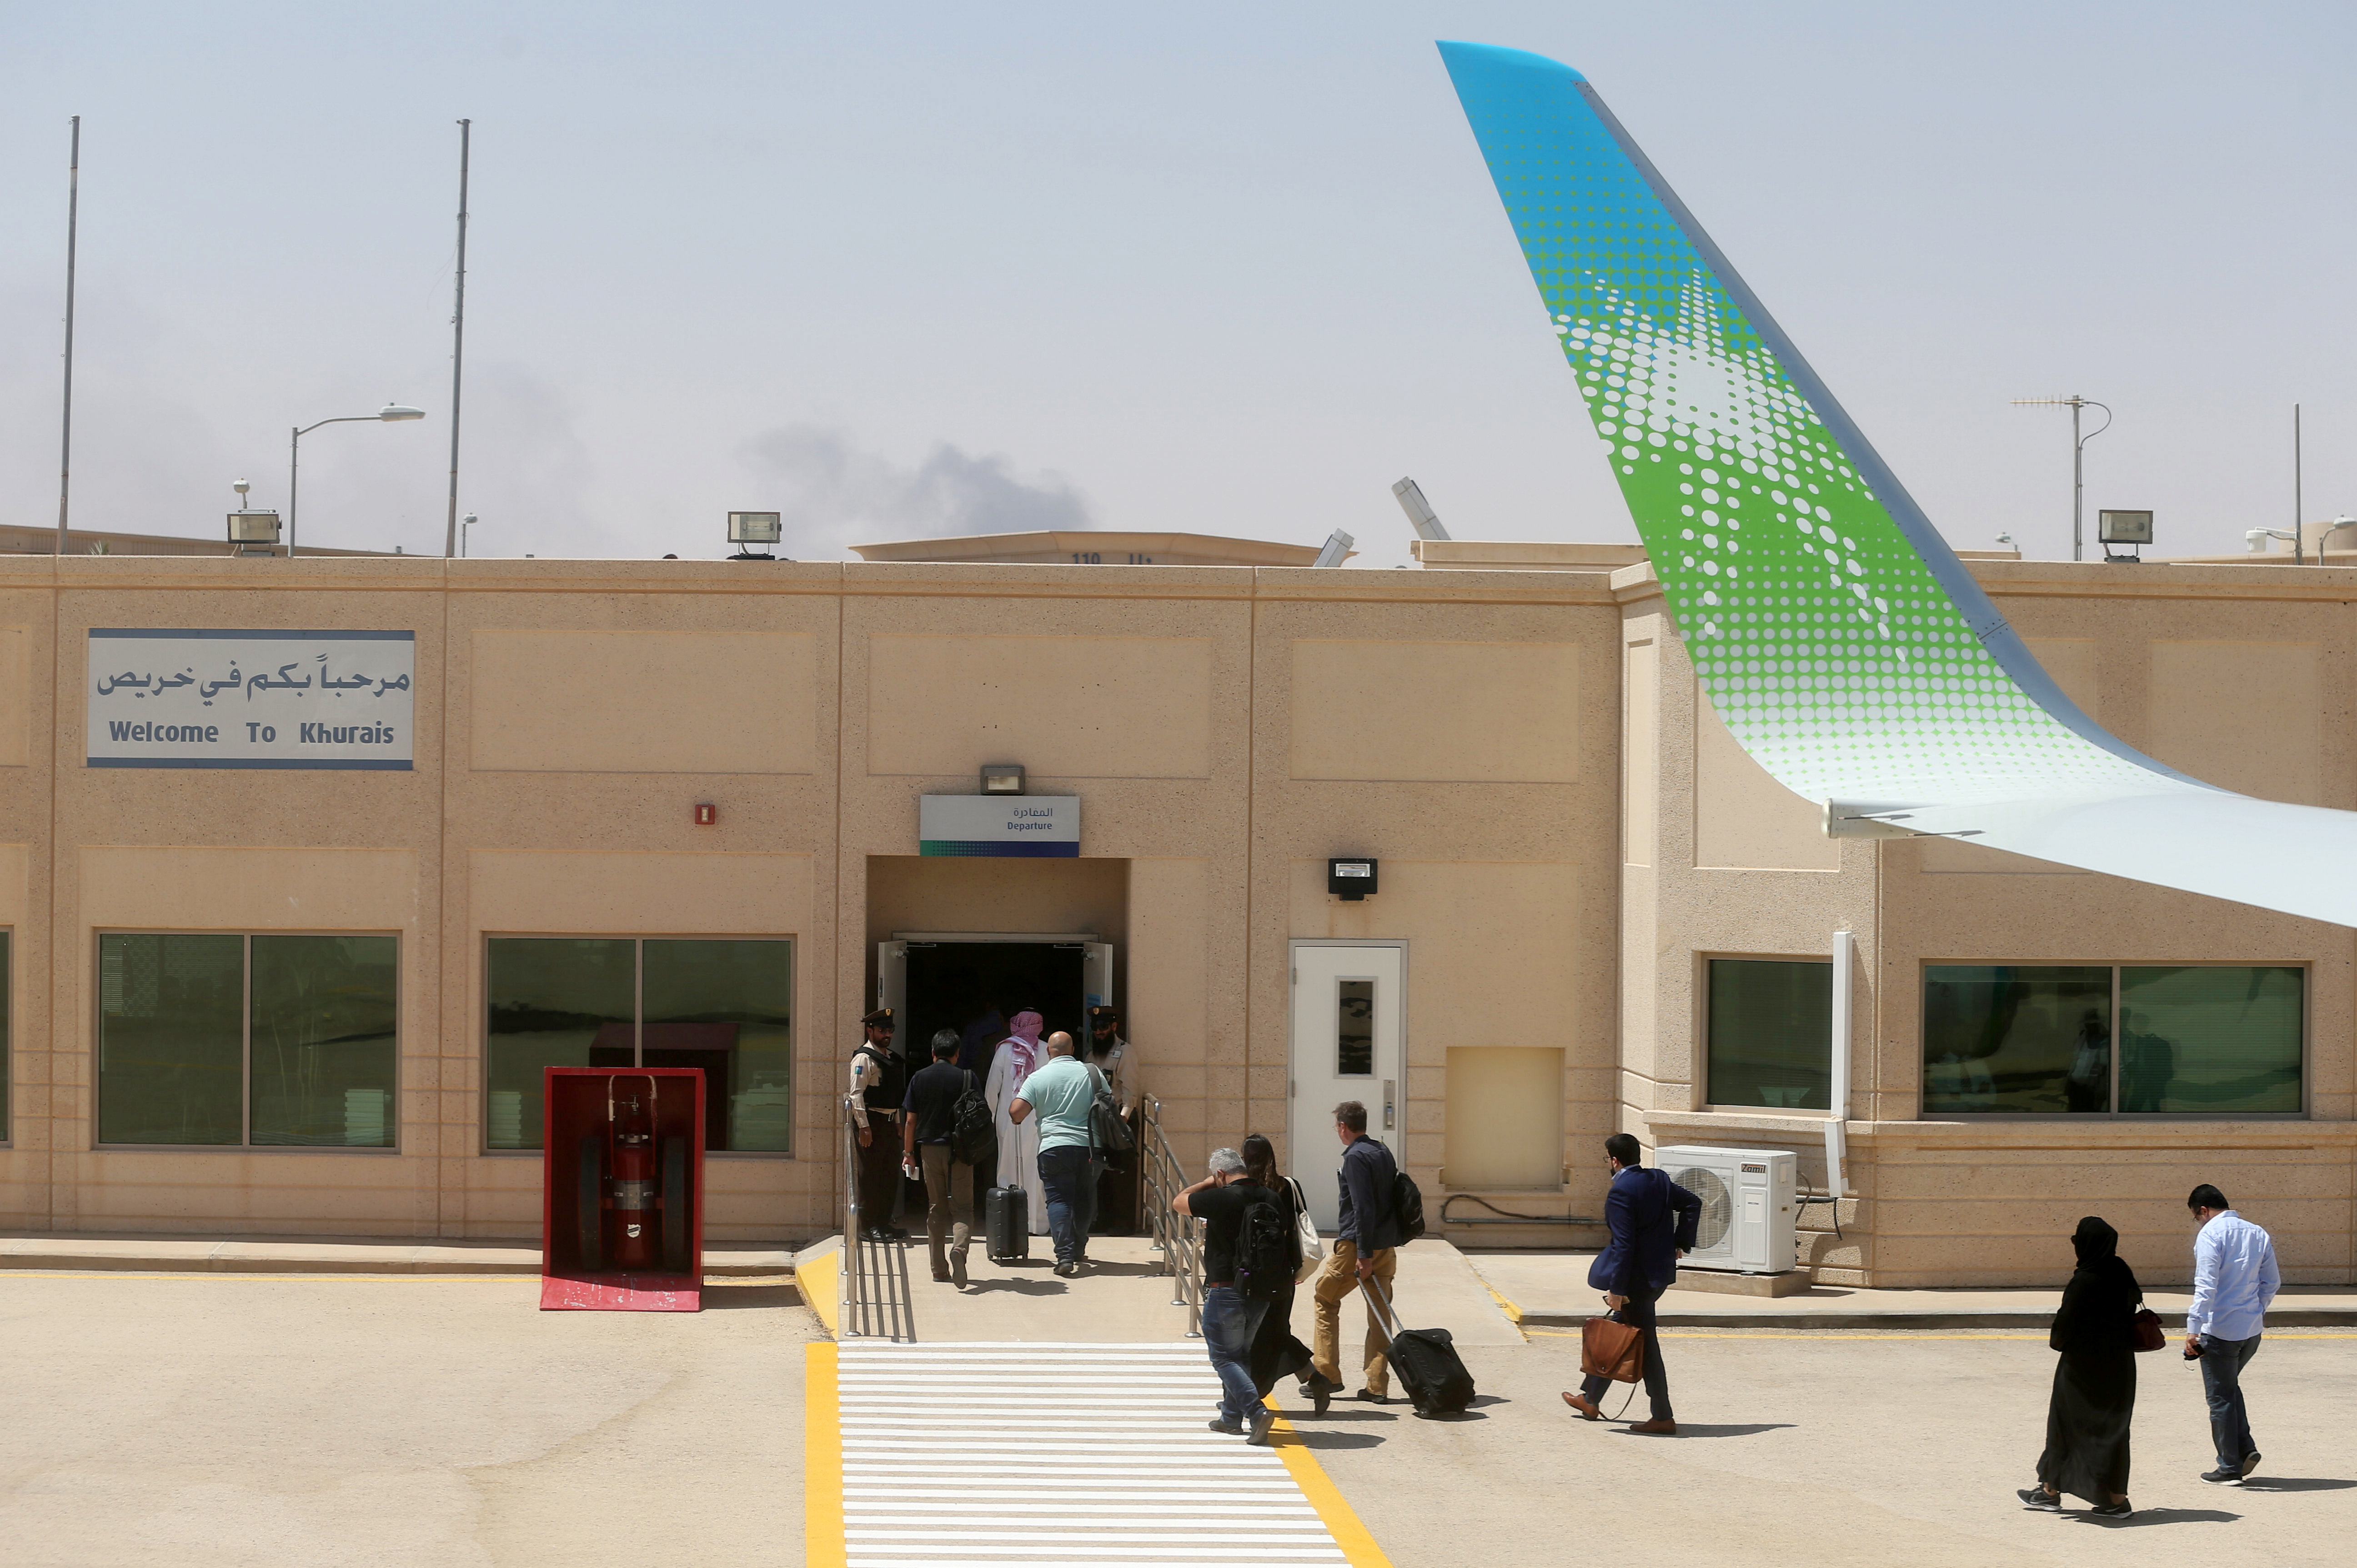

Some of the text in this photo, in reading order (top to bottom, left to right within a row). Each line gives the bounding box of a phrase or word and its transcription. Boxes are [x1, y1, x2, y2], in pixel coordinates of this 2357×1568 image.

[97, 667, 196, 698] خريص
[200, 660, 241, 706] في
[247, 662, 311, 702] بكم
[109, 721, 394, 744] Welcome To Khurais
[1013, 807, 1053, 819] المغادرة
[1007, 822, 1053, 832] Departure
[1741, 1164, 1766, 1173] Zamil
